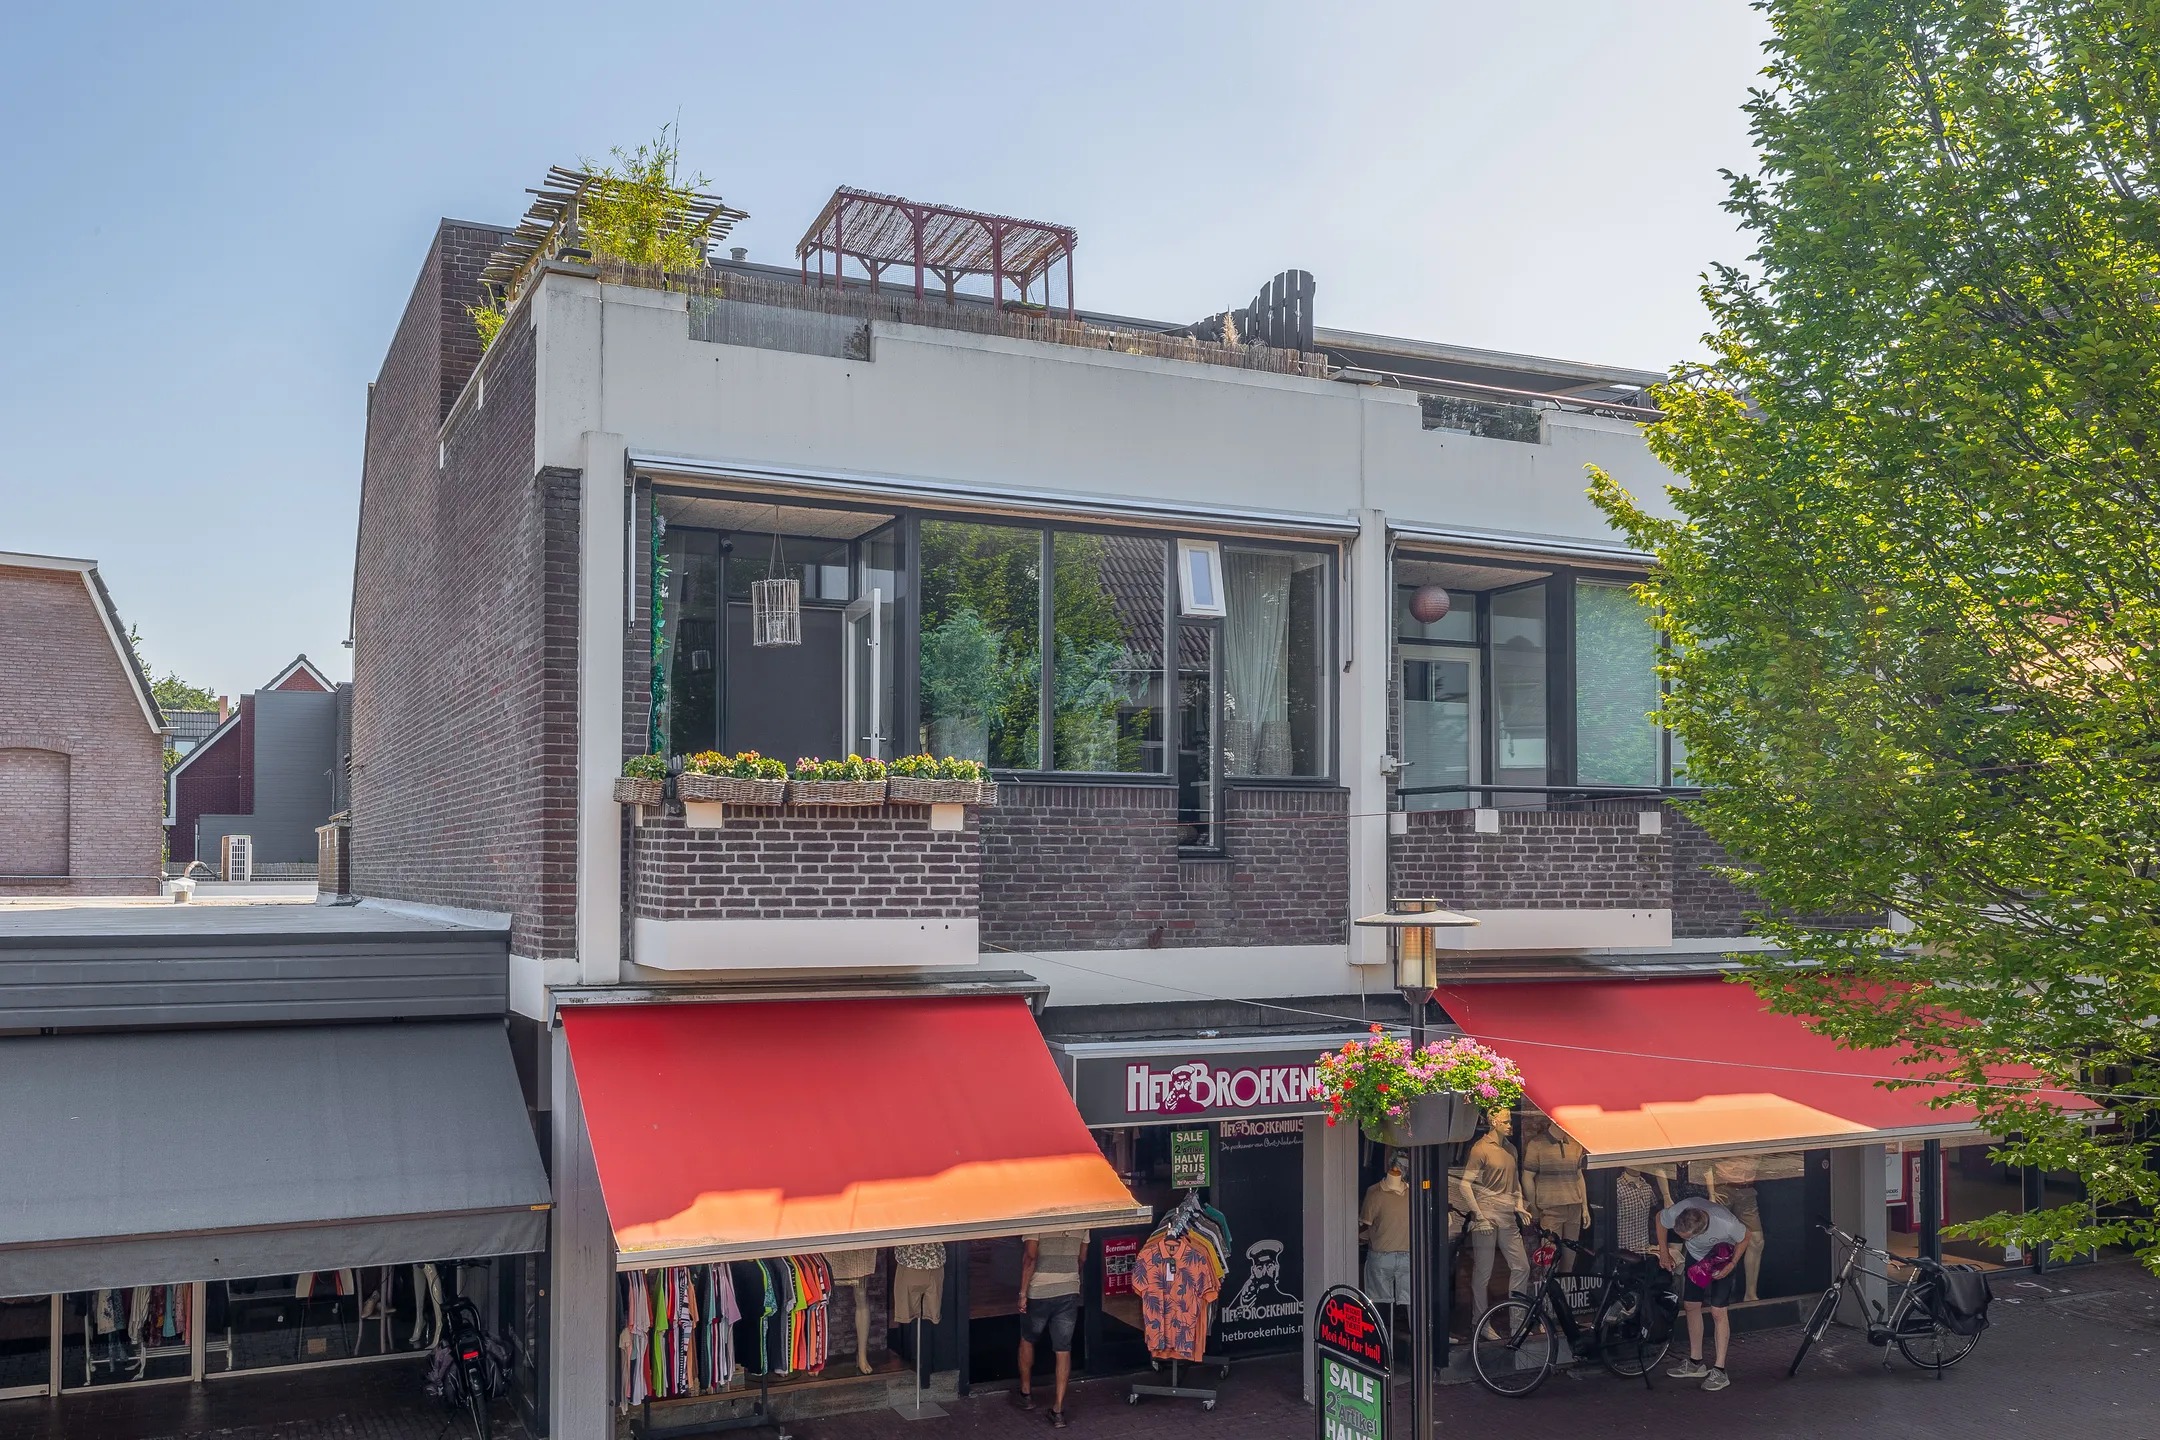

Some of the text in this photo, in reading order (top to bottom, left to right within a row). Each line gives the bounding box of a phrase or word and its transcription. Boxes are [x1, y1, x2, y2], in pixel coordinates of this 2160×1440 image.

[1239, 1119, 1304, 1136] BROEKENHUIS
[1176, 1131, 1203, 1142] SALE
[1174, 1153, 1206, 1164] HALVE
[1174, 1163, 1206, 1173] PRIJS
[1560, 1276, 1577, 1292] AJA
[1566, 1291, 1590, 1309] TURE
[1242, 1301, 1304, 1320] BROEKENHUIS
[1329, 1362, 1374, 1403] SALE
[1326, 1417, 1374, 1440] HAL
[1339, 1404, 1378, 1436] Artikel
